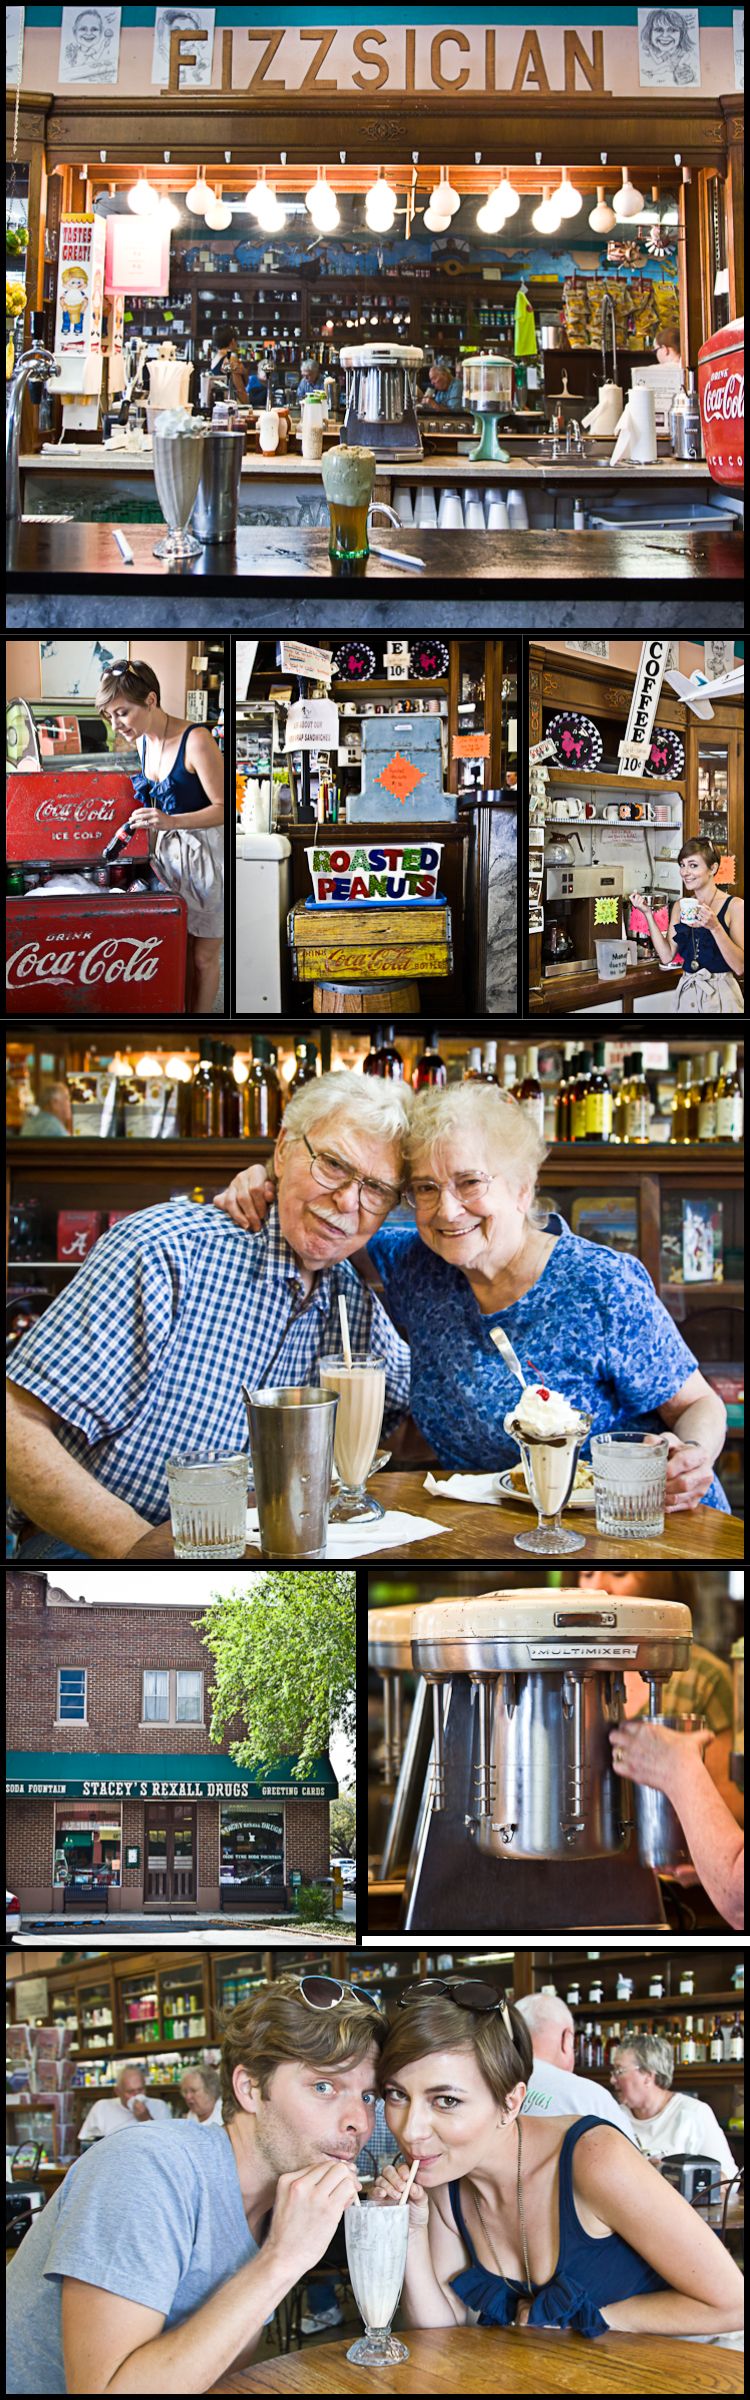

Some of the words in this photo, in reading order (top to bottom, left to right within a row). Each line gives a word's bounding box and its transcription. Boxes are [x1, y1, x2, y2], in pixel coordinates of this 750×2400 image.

[168, 29, 604, 92] FIZZSICIAN
[63, 227, 93, 243] TASTES
[62, 245, 91, 261] GREAT!
[710, 368, 729, 381] DRINK
[704, 373, 745, 423] Coca-Col
[728, 455, 745, 466] CO
[631, 641, 663, 743] COFFEE
[34, 798, 116, 822] Coca-Cola
[51, 832, 70, 840] ICE
[312, 847, 440, 873] ROASTED
[317, 872, 437, 901] PEANUTS
[46, 932, 93, 942] DRINK
[6, 936, 164, 990] Coca-Cola
[325, 947, 414, 973] Coca-Cola
[537, 1648, 632, 1656] MULTIMIXER
[6, 1784, 25, 1793] SODA
[28, 1784, 67, 1794] FOUNTAIN
[82, 1781, 148, 1796] STACEY'S
[151, 1781, 204, 1797] REXALL
[207, 1782, 249, 1797] DRUGS
[262, 1786, 299, 1796] GREETING
[301, 1786, 325, 1796] CARDS
